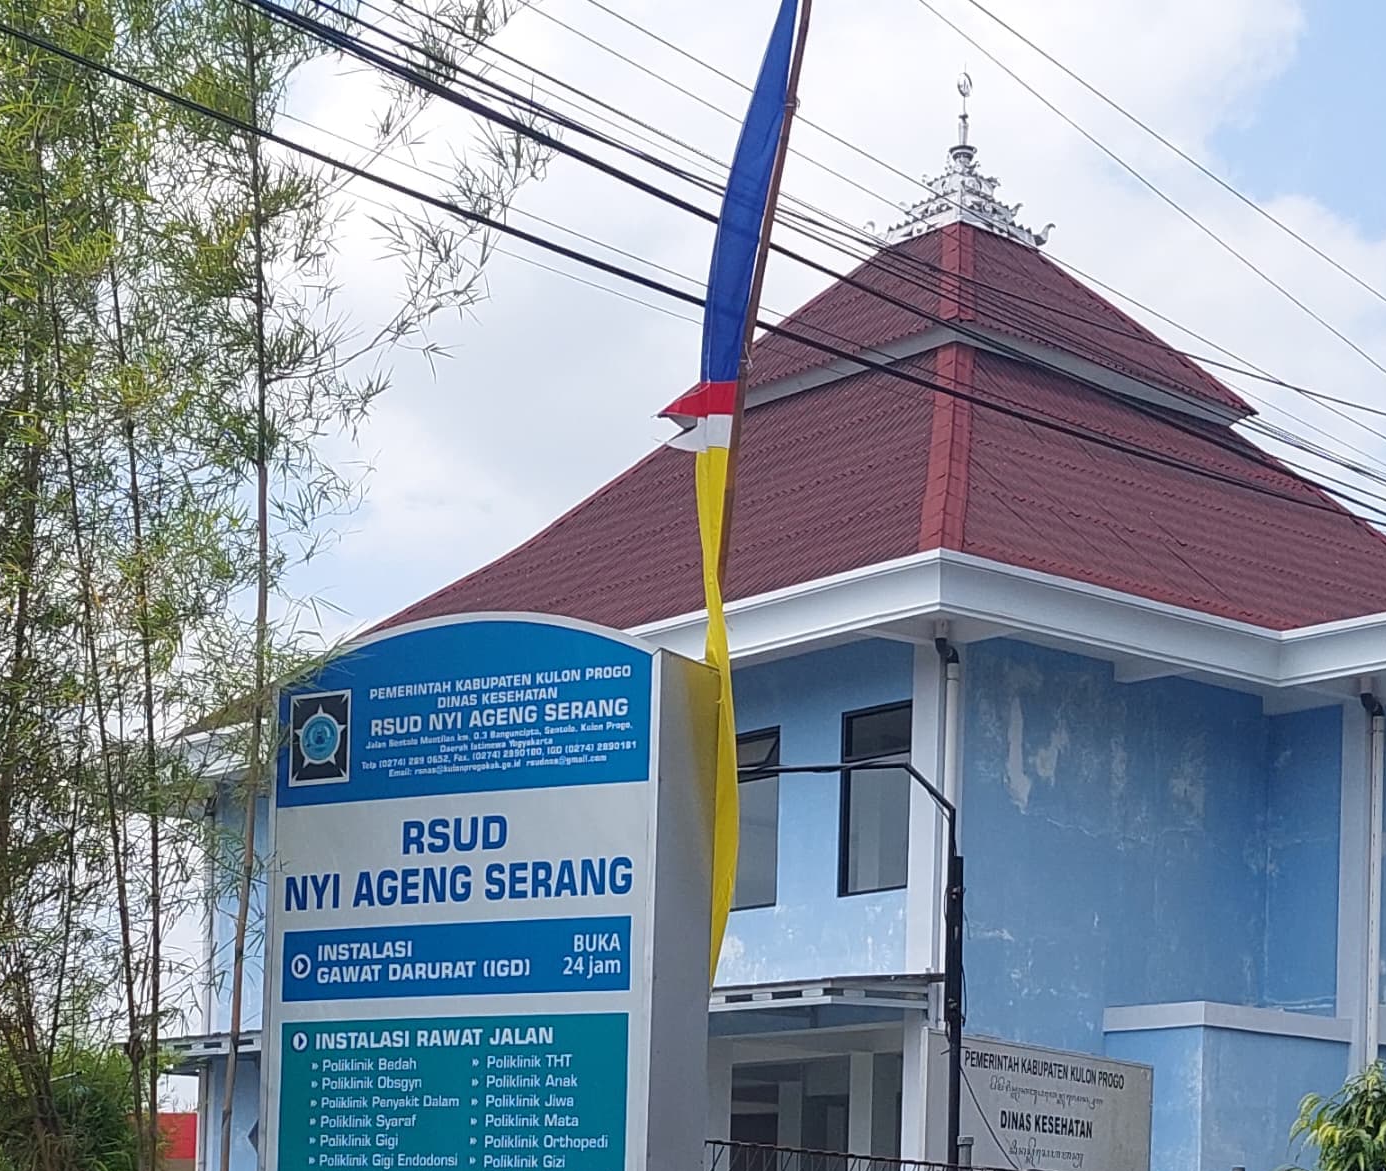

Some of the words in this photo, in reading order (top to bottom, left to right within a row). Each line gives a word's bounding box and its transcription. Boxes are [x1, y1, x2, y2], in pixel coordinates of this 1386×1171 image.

[369, 681, 451, 700] PEMERINTAH
[455, 673, 531, 692] KABUPATEN
[535, 669, 580, 685] KULON
[585, 665, 631, 680] PROGO
[437, 694, 477, 709] DINAS
[481, 687, 558, 705] KESEHATAN
[370, 715, 422, 736] RSUD
[428, 711, 462, 731] NYI
[469, 705, 538, 728] AGENG
[544, 698, 629, 721] SERANG
[365, 740, 387, 750] Jalan
[580, 723, 604, 732] Kulon
[439, 744, 468, 754] Daerah
[508, 737, 553, 749] Yogyakarta
[379, 758, 406, 770] (0274)
[472, 750, 501, 761] (0274)
[565, 743, 594, 755] (0274)
[401, 815, 508, 855] RSUD
[284, 872, 340, 912] NYI
[352, 864, 472, 908] AGENG
[484, 856, 633, 901] SERANG
[317, 940, 413, 962] INSTALASI
[573, 933, 621, 953] BUKA
[316, 964, 383, 984] GAWAT
[388, 960, 476, 982] DARURAT
[483, 958, 531, 978] (IGD)
[563, 956, 585, 976] 24
[586, 955, 622, 980] jam
[315, 1030, 410, 1050] INSTALASI
[416, 1028, 484, 1047] RAWAT
[489, 1026, 554, 1045] JALAN
[322, 1058, 374, 1072] Poliklinik
[378, 1057, 417, 1071] Bedah
[486, 1054, 541, 1069] Poliklinik
[545, 1054, 573, 1068] THT
[964, 1050, 1019, 1072] PEMERINTAH
[1020, 1057, 1068, 1081] KABUPATEN
[1070, 1065, 1097, 1084] KULON
[1098, 1071, 1125, 1090] PROGO
[321, 1077, 373, 1090] Poliklinik
[377, 1076, 422, 1092] Obsgyn
[486, 1074, 541, 1088] Poliklinik
[545, 1074, 578, 1088] Anak
[321, 1096, 368, 1109] Poliklinik
[372, 1096, 419, 1111] Penyakit
[423, 1095, 460, 1108] Dalam
[485, 1094, 540, 1108] Poliklinik
[544, 1093, 574, 1107] Jiwa
[320, 1115, 372, 1128] Poliklinik
[375, 1114, 417, 1130] Syaraf
[485, 1114, 539, 1128] Poliklinik
[544, 1114, 579, 1127] Mata
[1000, 1109, 1031, 1132] DINAS
[1034, 1114, 1093, 1139] KESEHATAN
[320, 1134, 371, 1147] Poliklinik
[375, 1134, 399, 1150] Gigi
[484, 1135, 539, 1149] Poliklinik
[543, 1134, 608, 1151] Orthopedi
[319, 1153, 368, 1167] Poliklinik
[372, 1153, 394, 1170] Gigi
[397, 1152, 458, 1167] Endodonsi
[483, 1154, 538, 1169] Poliklinik
[543, 1154, 566, 1168] Gizi
